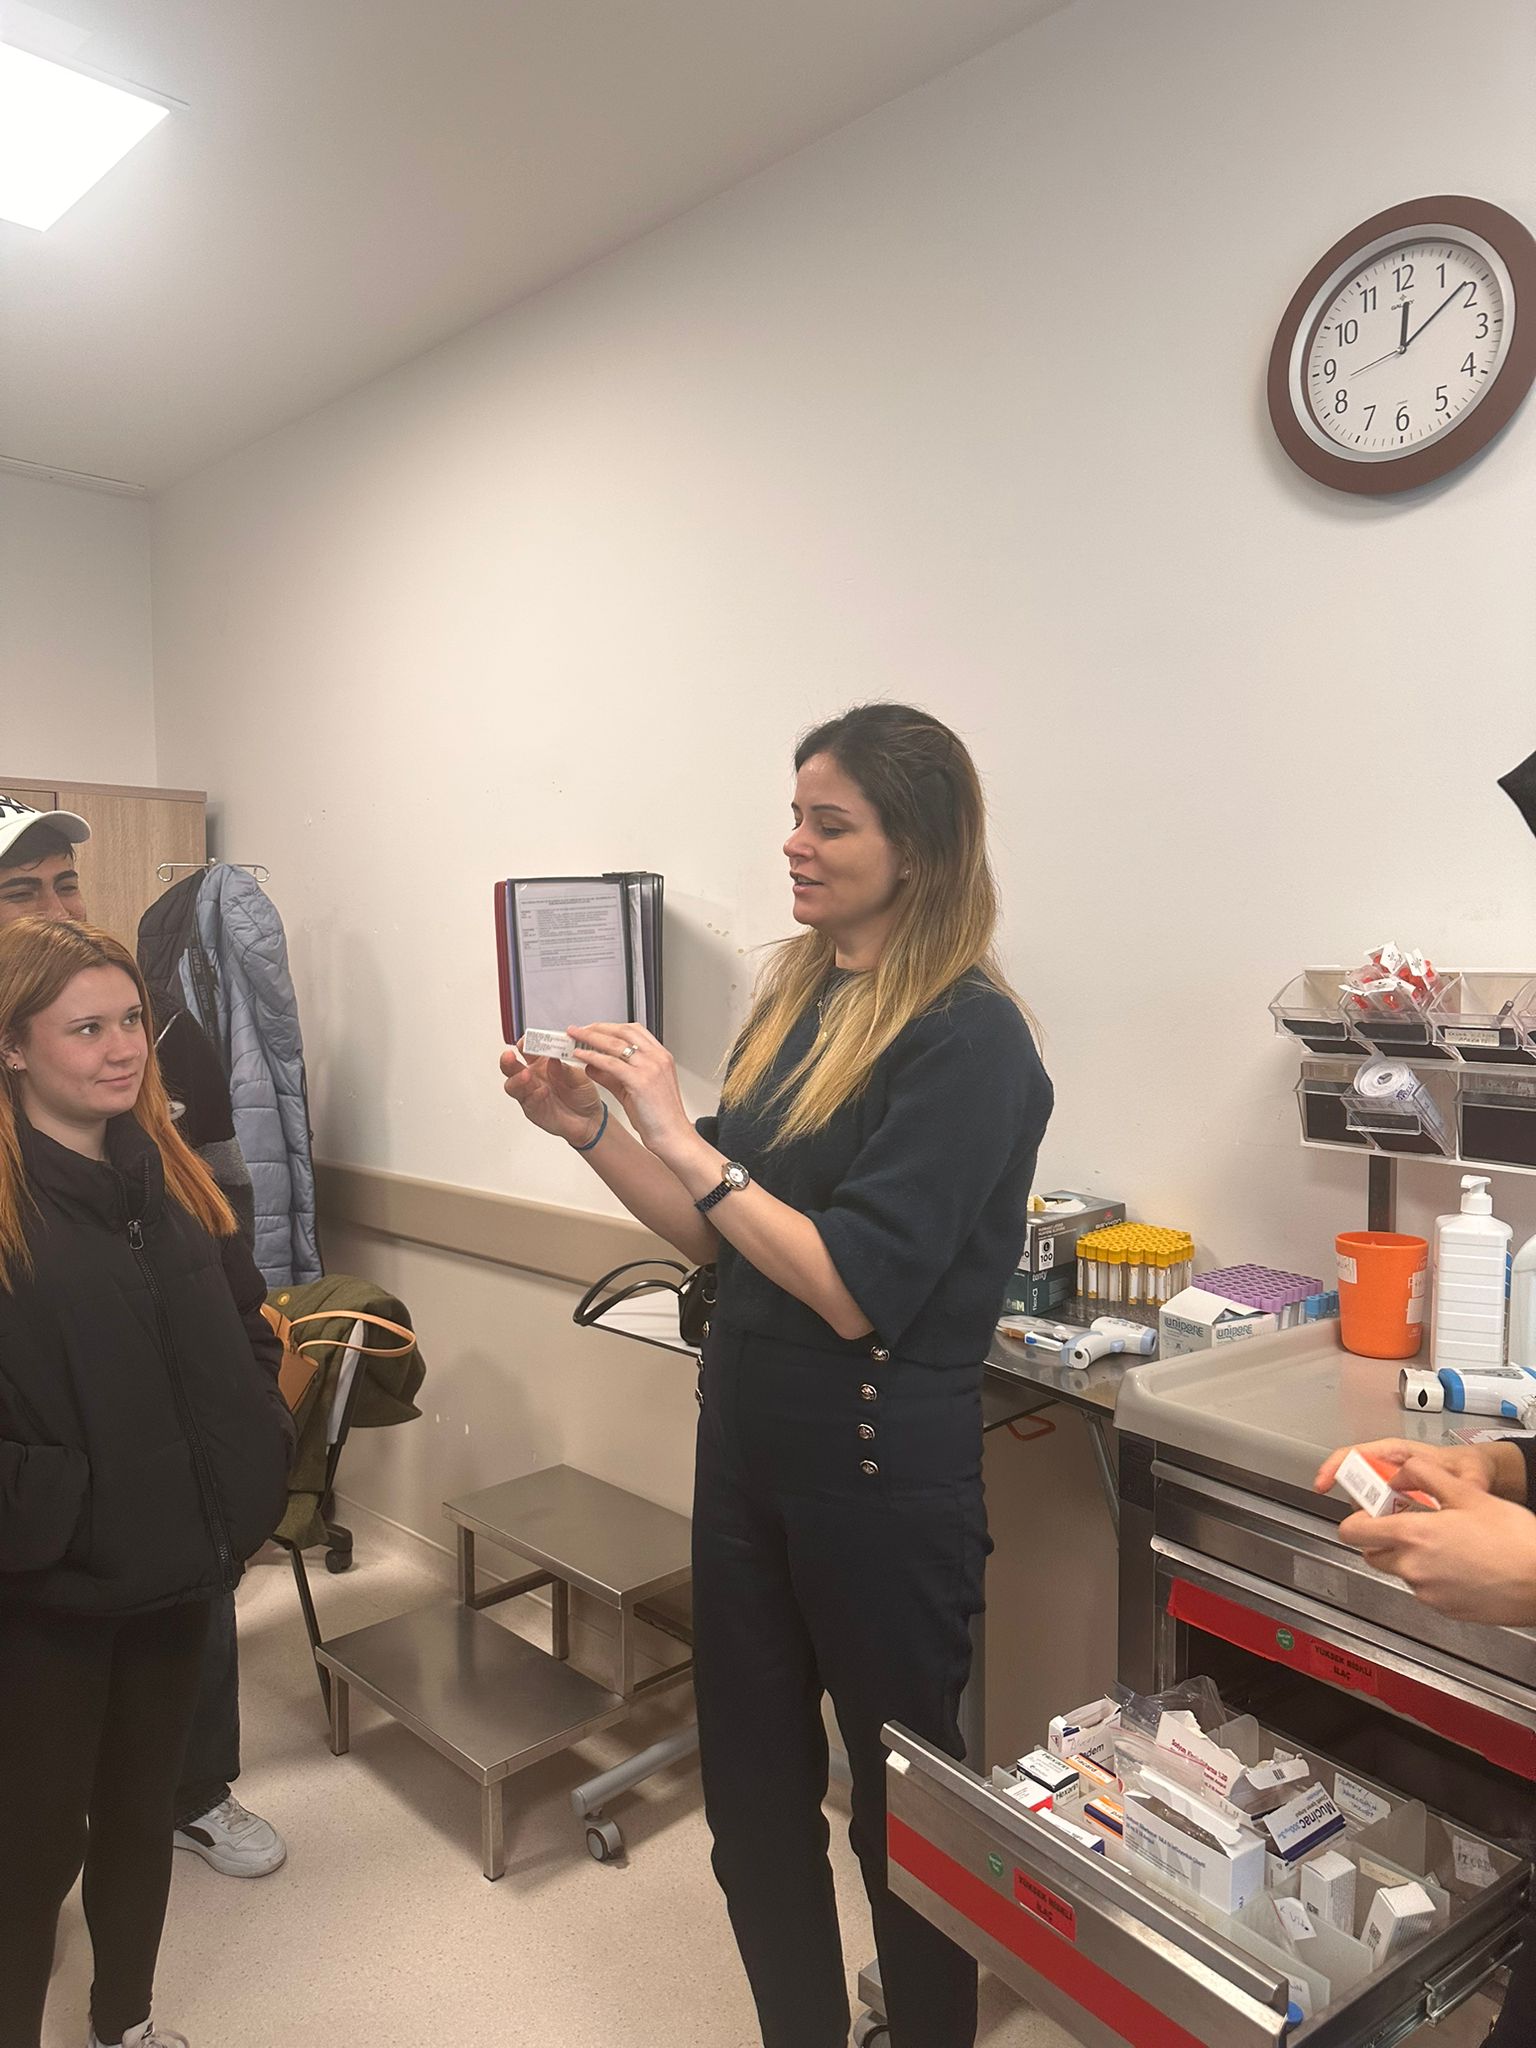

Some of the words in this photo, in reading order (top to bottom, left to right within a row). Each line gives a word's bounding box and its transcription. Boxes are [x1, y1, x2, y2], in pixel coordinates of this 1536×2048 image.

[1391, 264, 1414, 292] 12
[1436, 263, 1445, 288] 1
[1359, 286, 1377, 313] 11
[1463, 281, 1477, 308] 2
[1335, 319, 1359, 347] 10
[1475, 313, 1489, 339] 3
[1323, 359, 1337, 384] 9
[1460, 352, 1476, 378] 4
[1335, 389, 1348, 414] 8
[1434, 385, 1448, 412] 5
[1363, 405, 1376, 431] 7
[1395, 406, 1410, 431] 6
[1040, 1253, 1053, 1263] 100
[1299, 1800, 1337, 1829] Mucinac
